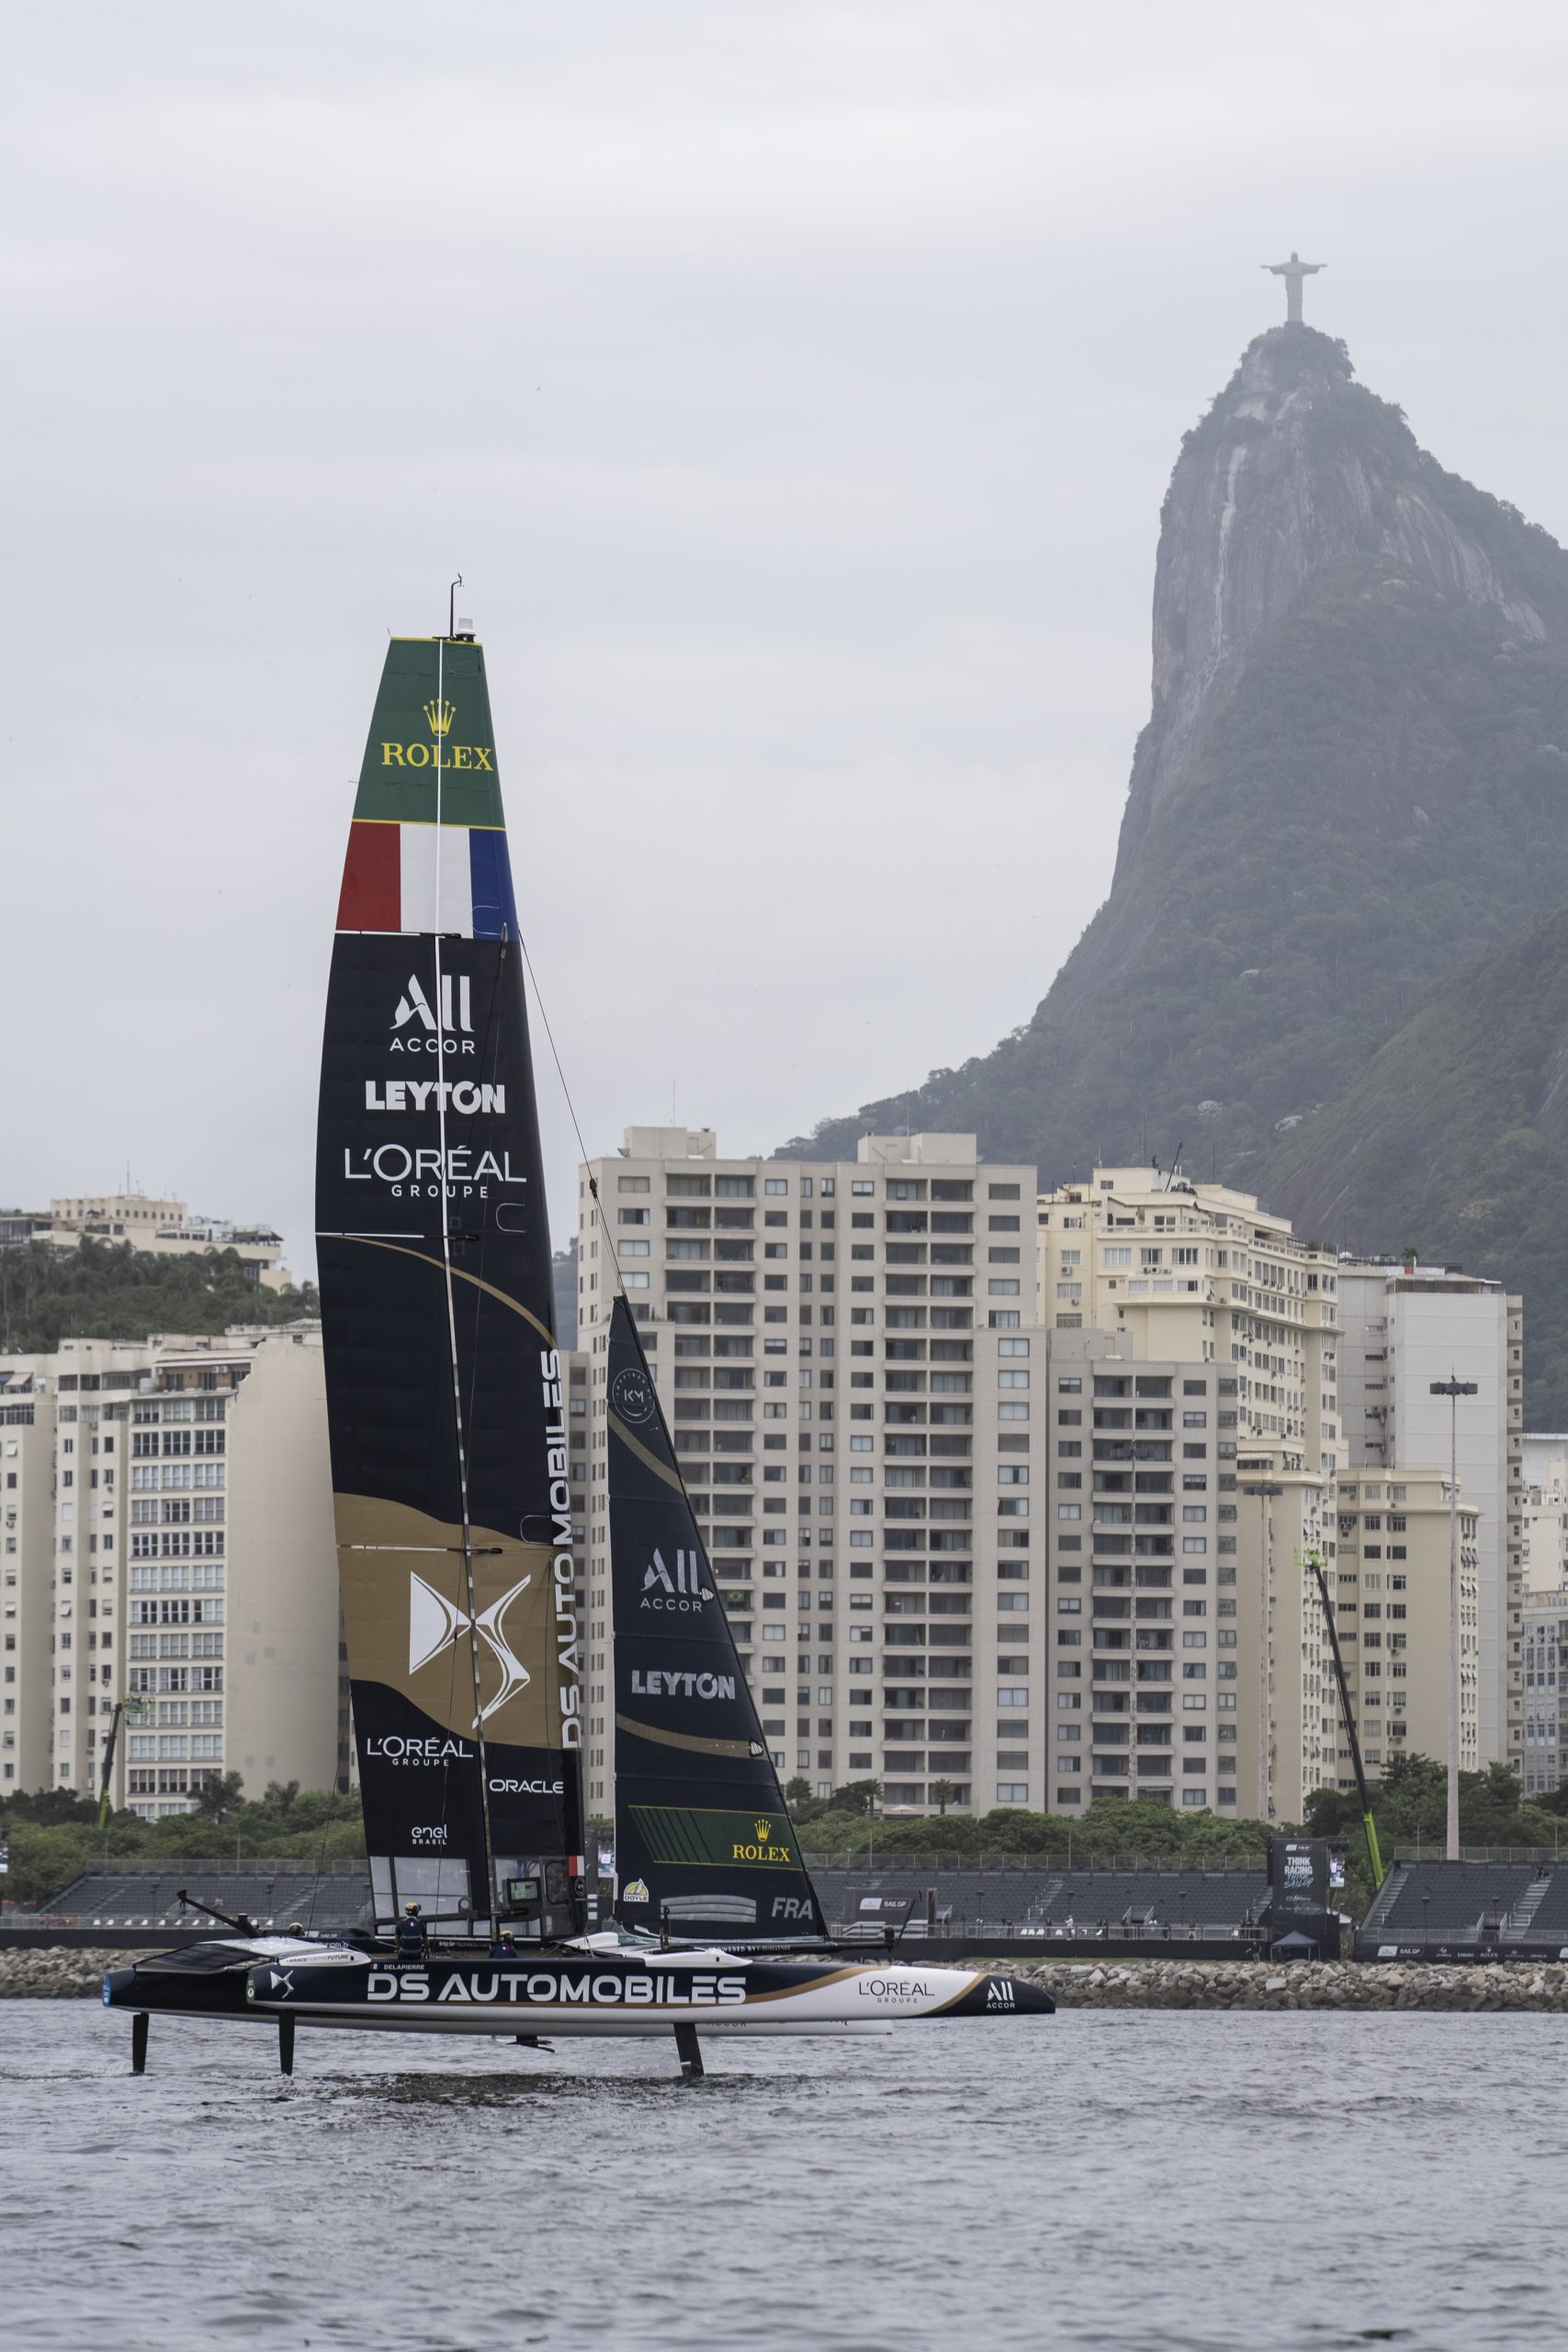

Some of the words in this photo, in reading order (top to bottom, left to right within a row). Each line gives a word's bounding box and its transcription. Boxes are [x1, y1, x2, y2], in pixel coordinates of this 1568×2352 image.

[381, 742, 494, 772] ROLEX
[389, 1037, 476, 1054] ACCOR
[366, 1080, 506, 1114] LEYTON
[344, 1144, 527, 1182] L'ORÉAL
[391, 1184, 489, 1199] GROUPE
[540, 1348, 580, 1674] AUTOMOBILES
[640, 1597, 703, 1613] ACCOR
[631, 1669, 736, 1701] LEYTON
[559, 1682, 581, 1749] DS
[367, 1736, 474, 1758] L'ORÉAL
[392, 1758, 449, 1767] GROUPE
[489, 1779, 564, 1793] ORACLE
[412, 1824, 448, 1838] enel
[732, 1844, 791, 1862] ROLEX
[1287, 1856, 1311, 1865] THINK
[1284, 1865, 1313, 1874] RACING
[772, 1896, 814, 1919] FRA
[367, 1973, 429, 2001] DS
[437, 1973, 746, 2005] AUTOMOBILES
[859, 1979, 935, 1996] L'ORÉAL
